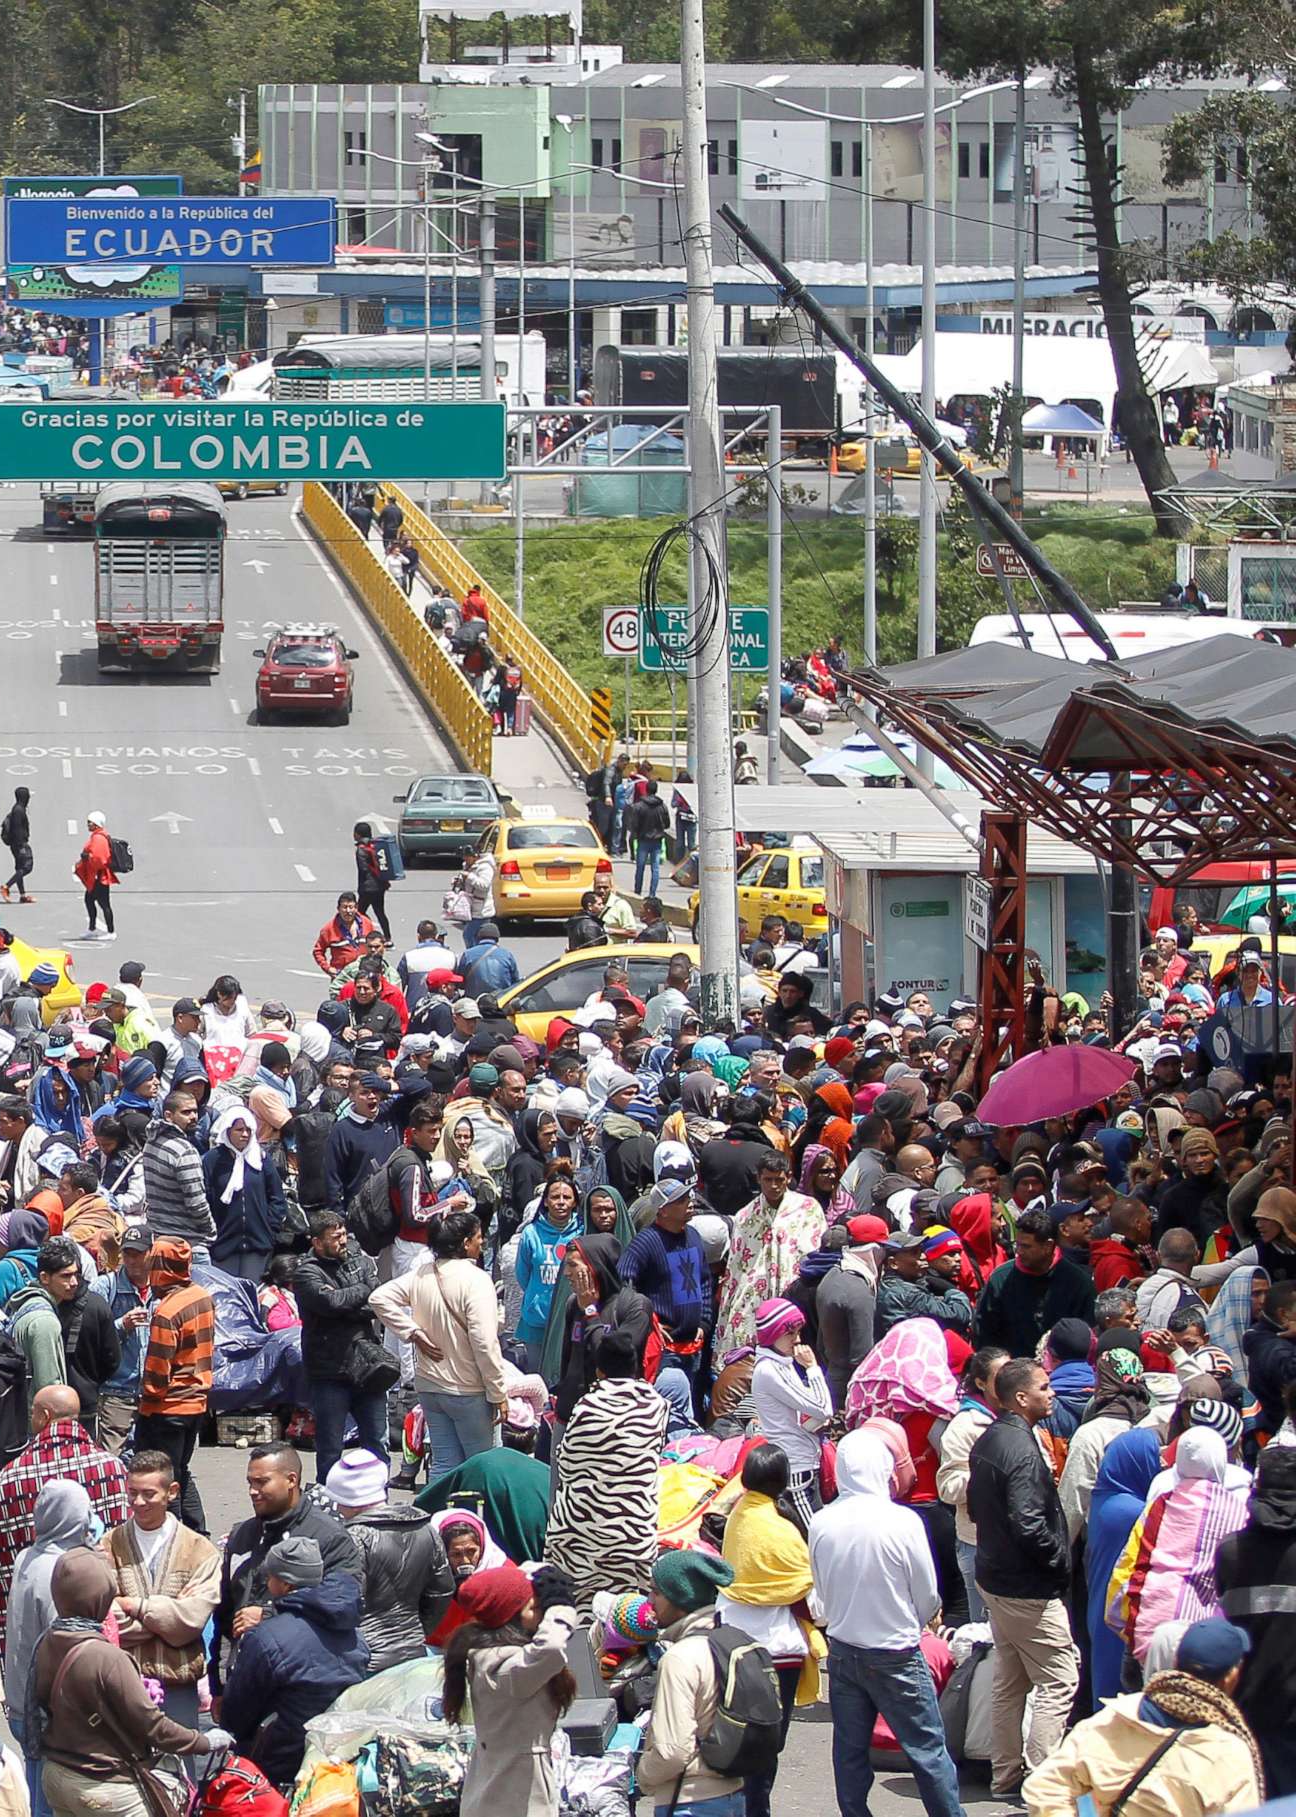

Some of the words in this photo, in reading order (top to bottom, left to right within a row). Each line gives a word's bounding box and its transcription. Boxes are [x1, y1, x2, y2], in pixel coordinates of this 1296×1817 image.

[66, 207, 145, 220] Bienvenido
[149, 210, 157, 220] a
[162, 207, 174, 220] la
[180, 206, 248, 222] República
[253, 207, 273, 220] del
[65, 229, 274, 256] ECUADOR
[21, 410, 108, 428] Gracias
[116, 413, 155, 430] por
[163, 410, 235, 428] visitar
[245, 410, 264, 427] la
[272, 409, 388, 431] República
[396, 410, 424, 427] de
[72, 435, 372, 470] COLOMBIA
[612, 621, 637, 638] 48
[75, 746, 246, 759] LIVIANOS
[282, 747, 410, 760] TAXIS
[96, 764, 229, 775] SOLO
[285, 765, 418, 777] SOLO
[892, 980, 934, 989] FONTUR
